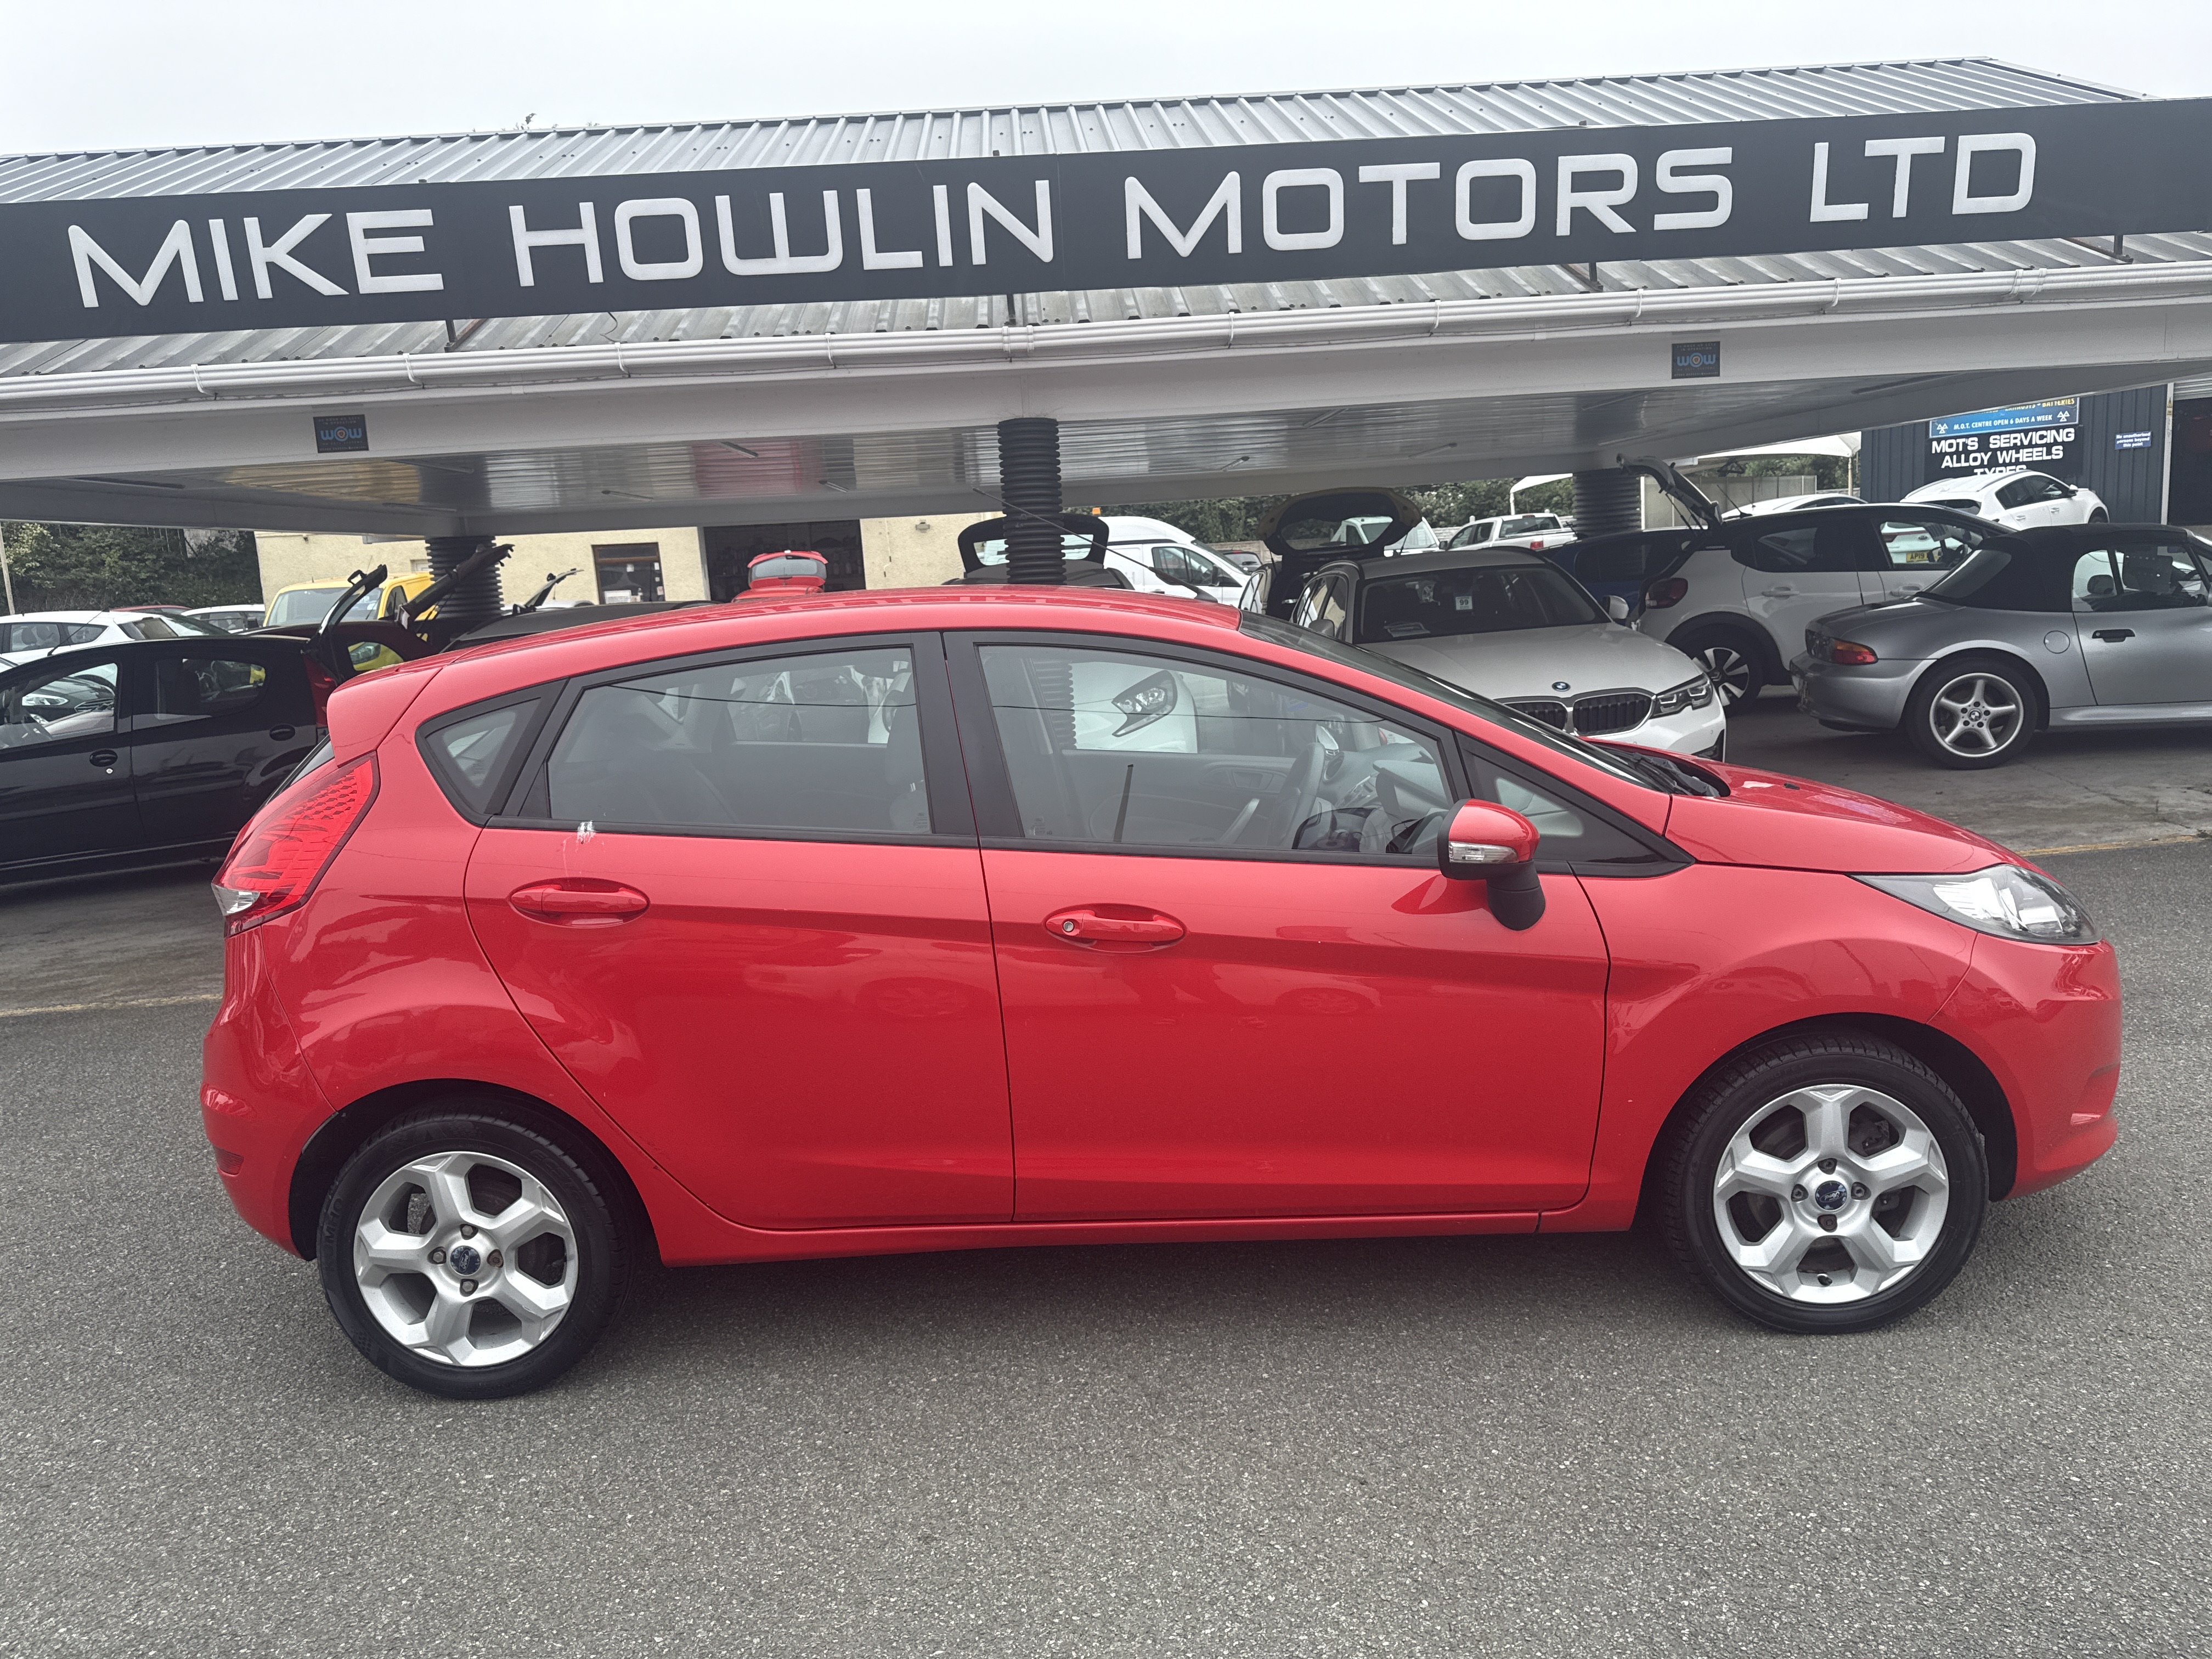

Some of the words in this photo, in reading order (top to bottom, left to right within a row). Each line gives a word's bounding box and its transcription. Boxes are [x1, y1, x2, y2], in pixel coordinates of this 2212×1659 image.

[67, 208, 444, 308] MIKE
[509, 179, 1053, 287] HOWLIN
[1124, 146, 1733, 259] MOTORS
[1809, 132, 2036, 222] LTD
[1932, 437, 1978, 454] MOT'S
[1989, 427, 2075, 449] SERVICING
[1941, 451, 1992, 469] ALLOY
[1997, 445, 2063, 464] WHEELS
